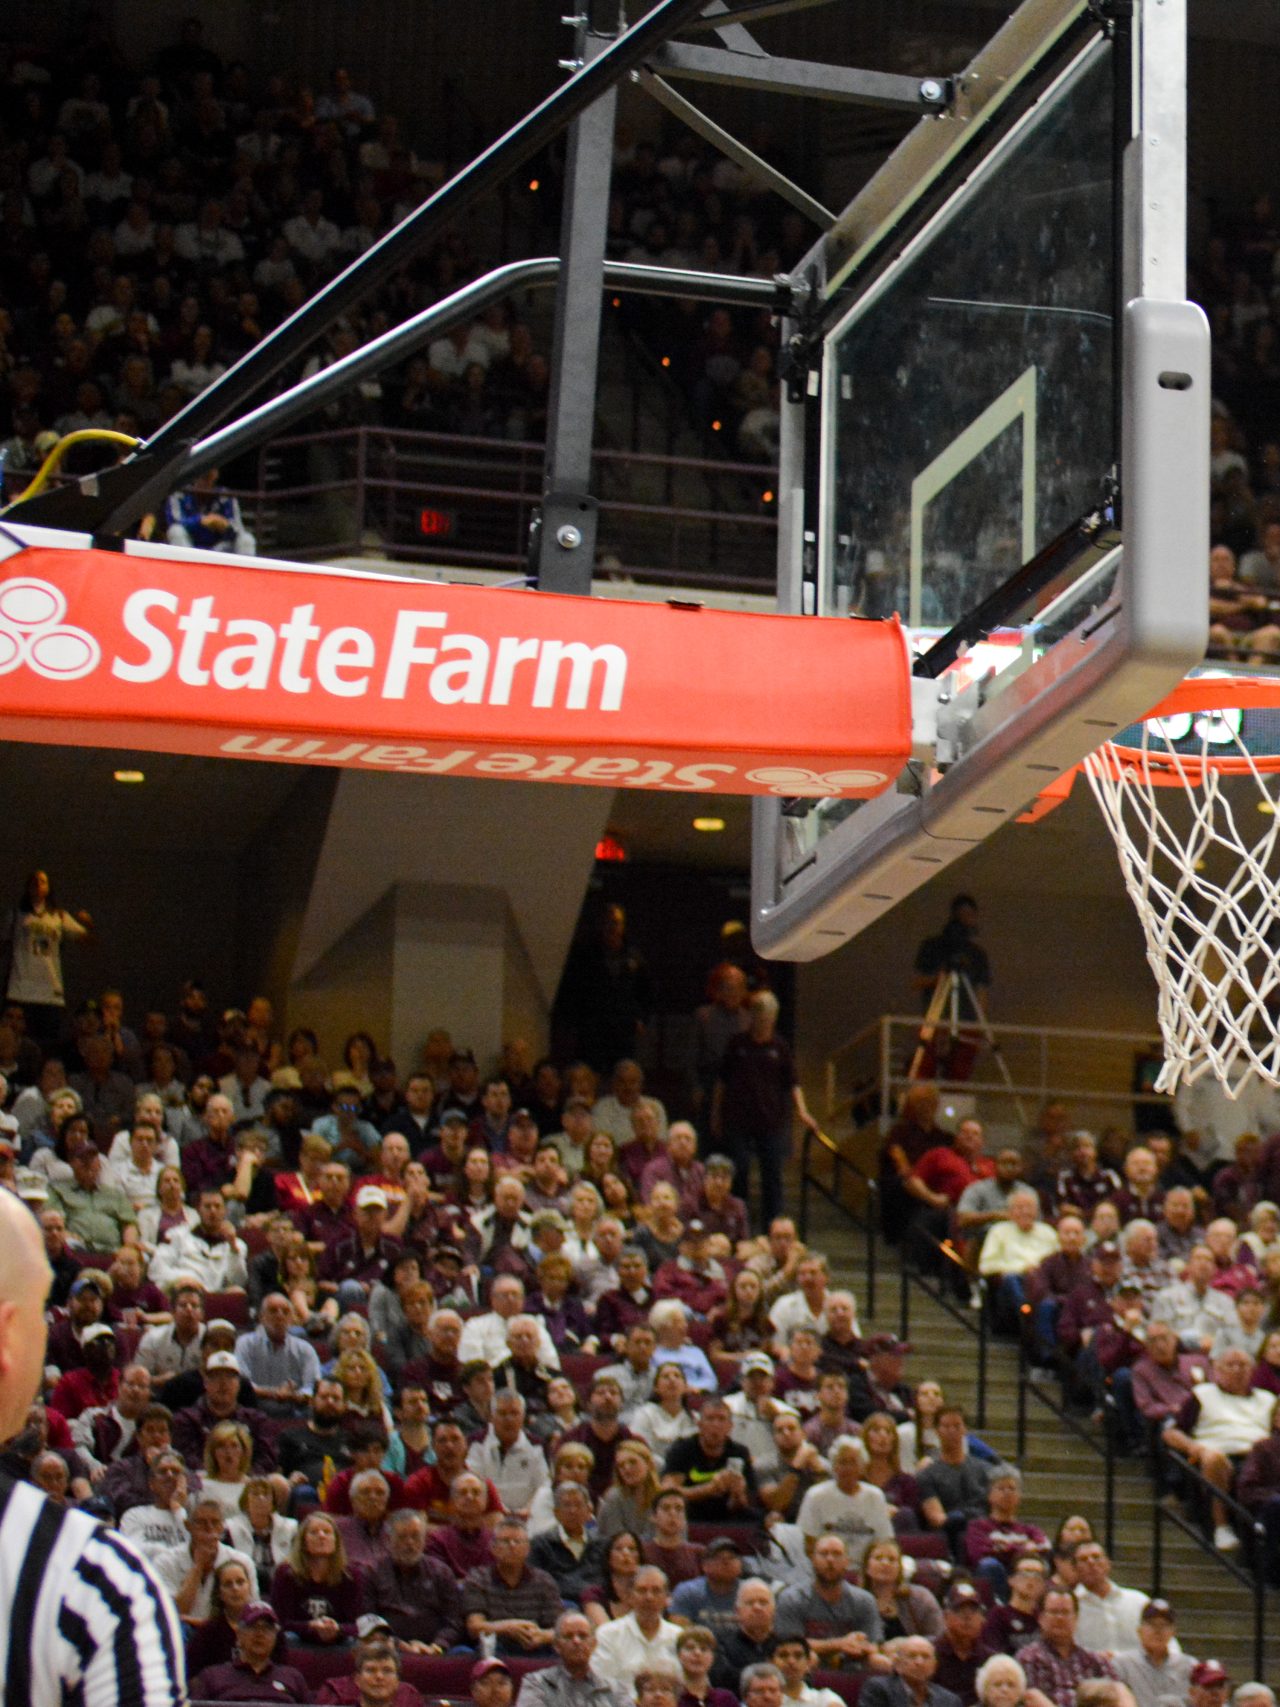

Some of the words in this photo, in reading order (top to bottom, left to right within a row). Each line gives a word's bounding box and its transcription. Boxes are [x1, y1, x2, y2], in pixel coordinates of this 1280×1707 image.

[111, 588, 376, 698] State
[381, 609, 628, 712] Farm
[219, 734, 478, 774] Farm
[475, 750, 738, 791] State
